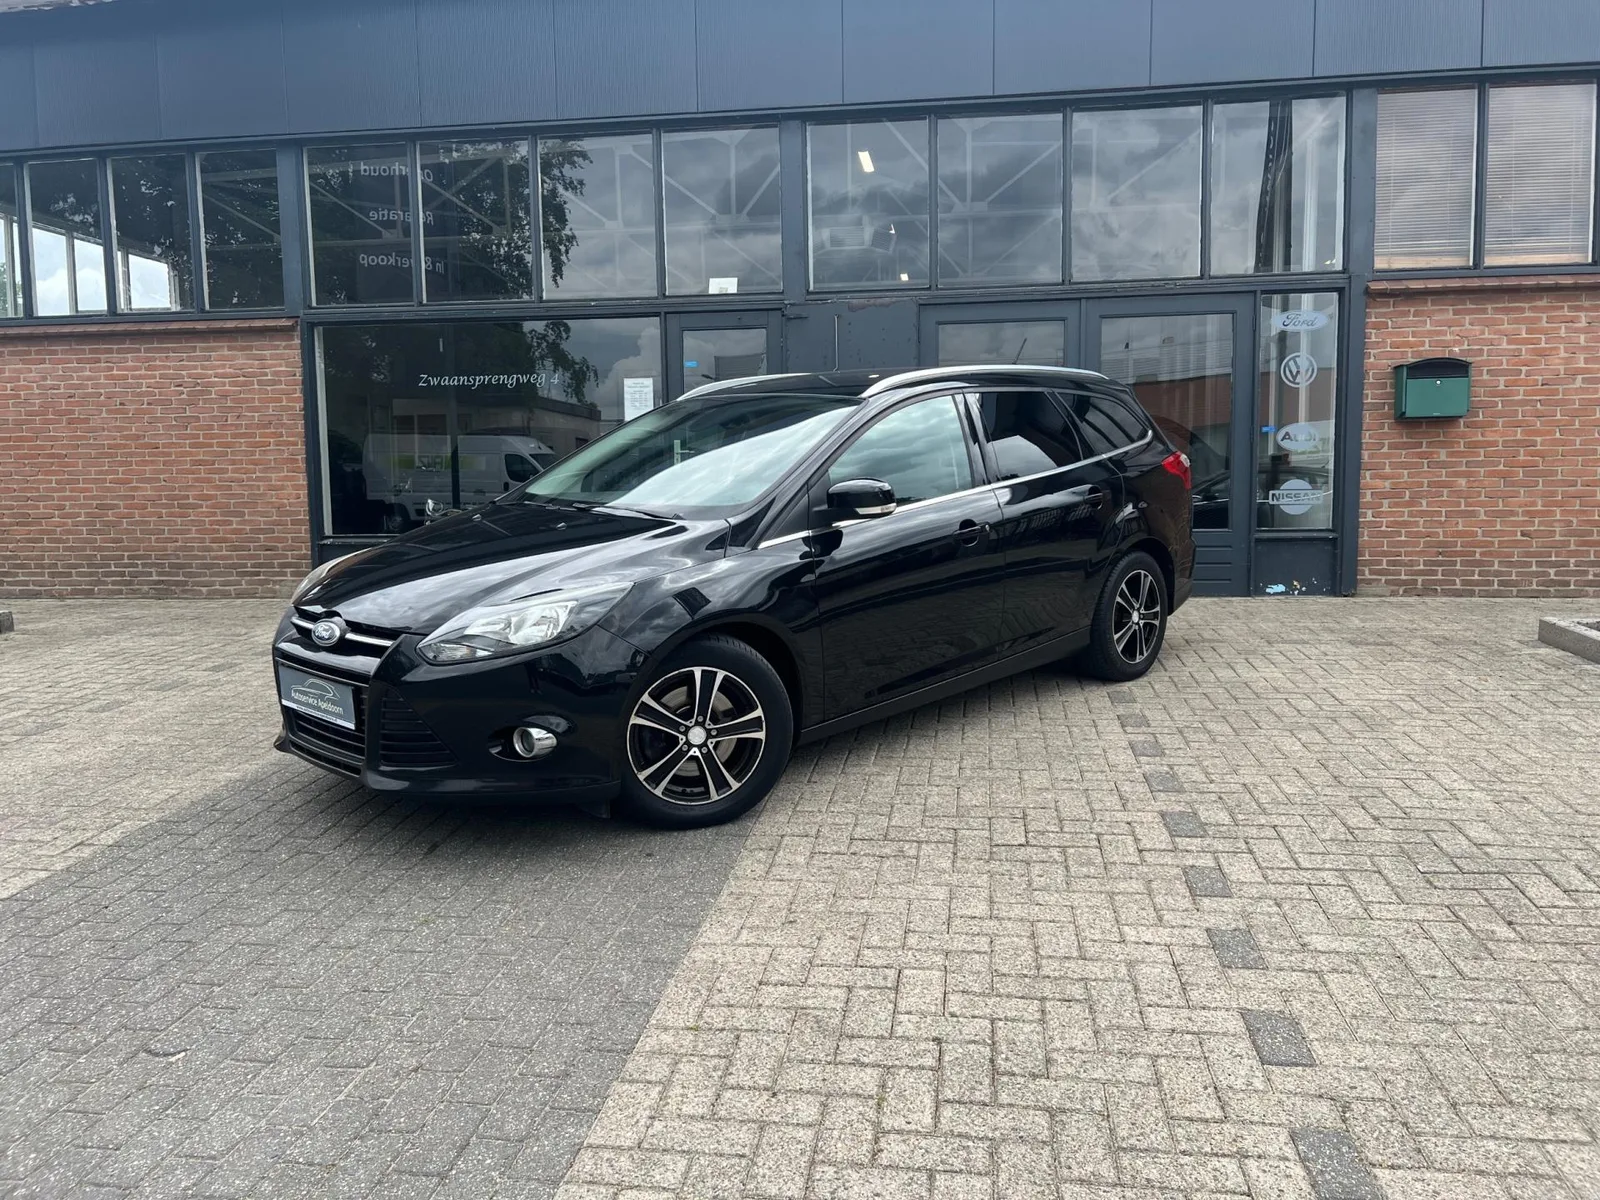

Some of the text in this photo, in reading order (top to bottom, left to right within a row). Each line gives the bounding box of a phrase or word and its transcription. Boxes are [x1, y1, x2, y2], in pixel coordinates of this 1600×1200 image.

[1282, 313, 1318, 327] Ford
[418, 373, 560, 390] Zwaansprengweg 4
[1271, 492, 1321, 502] NISSAN
